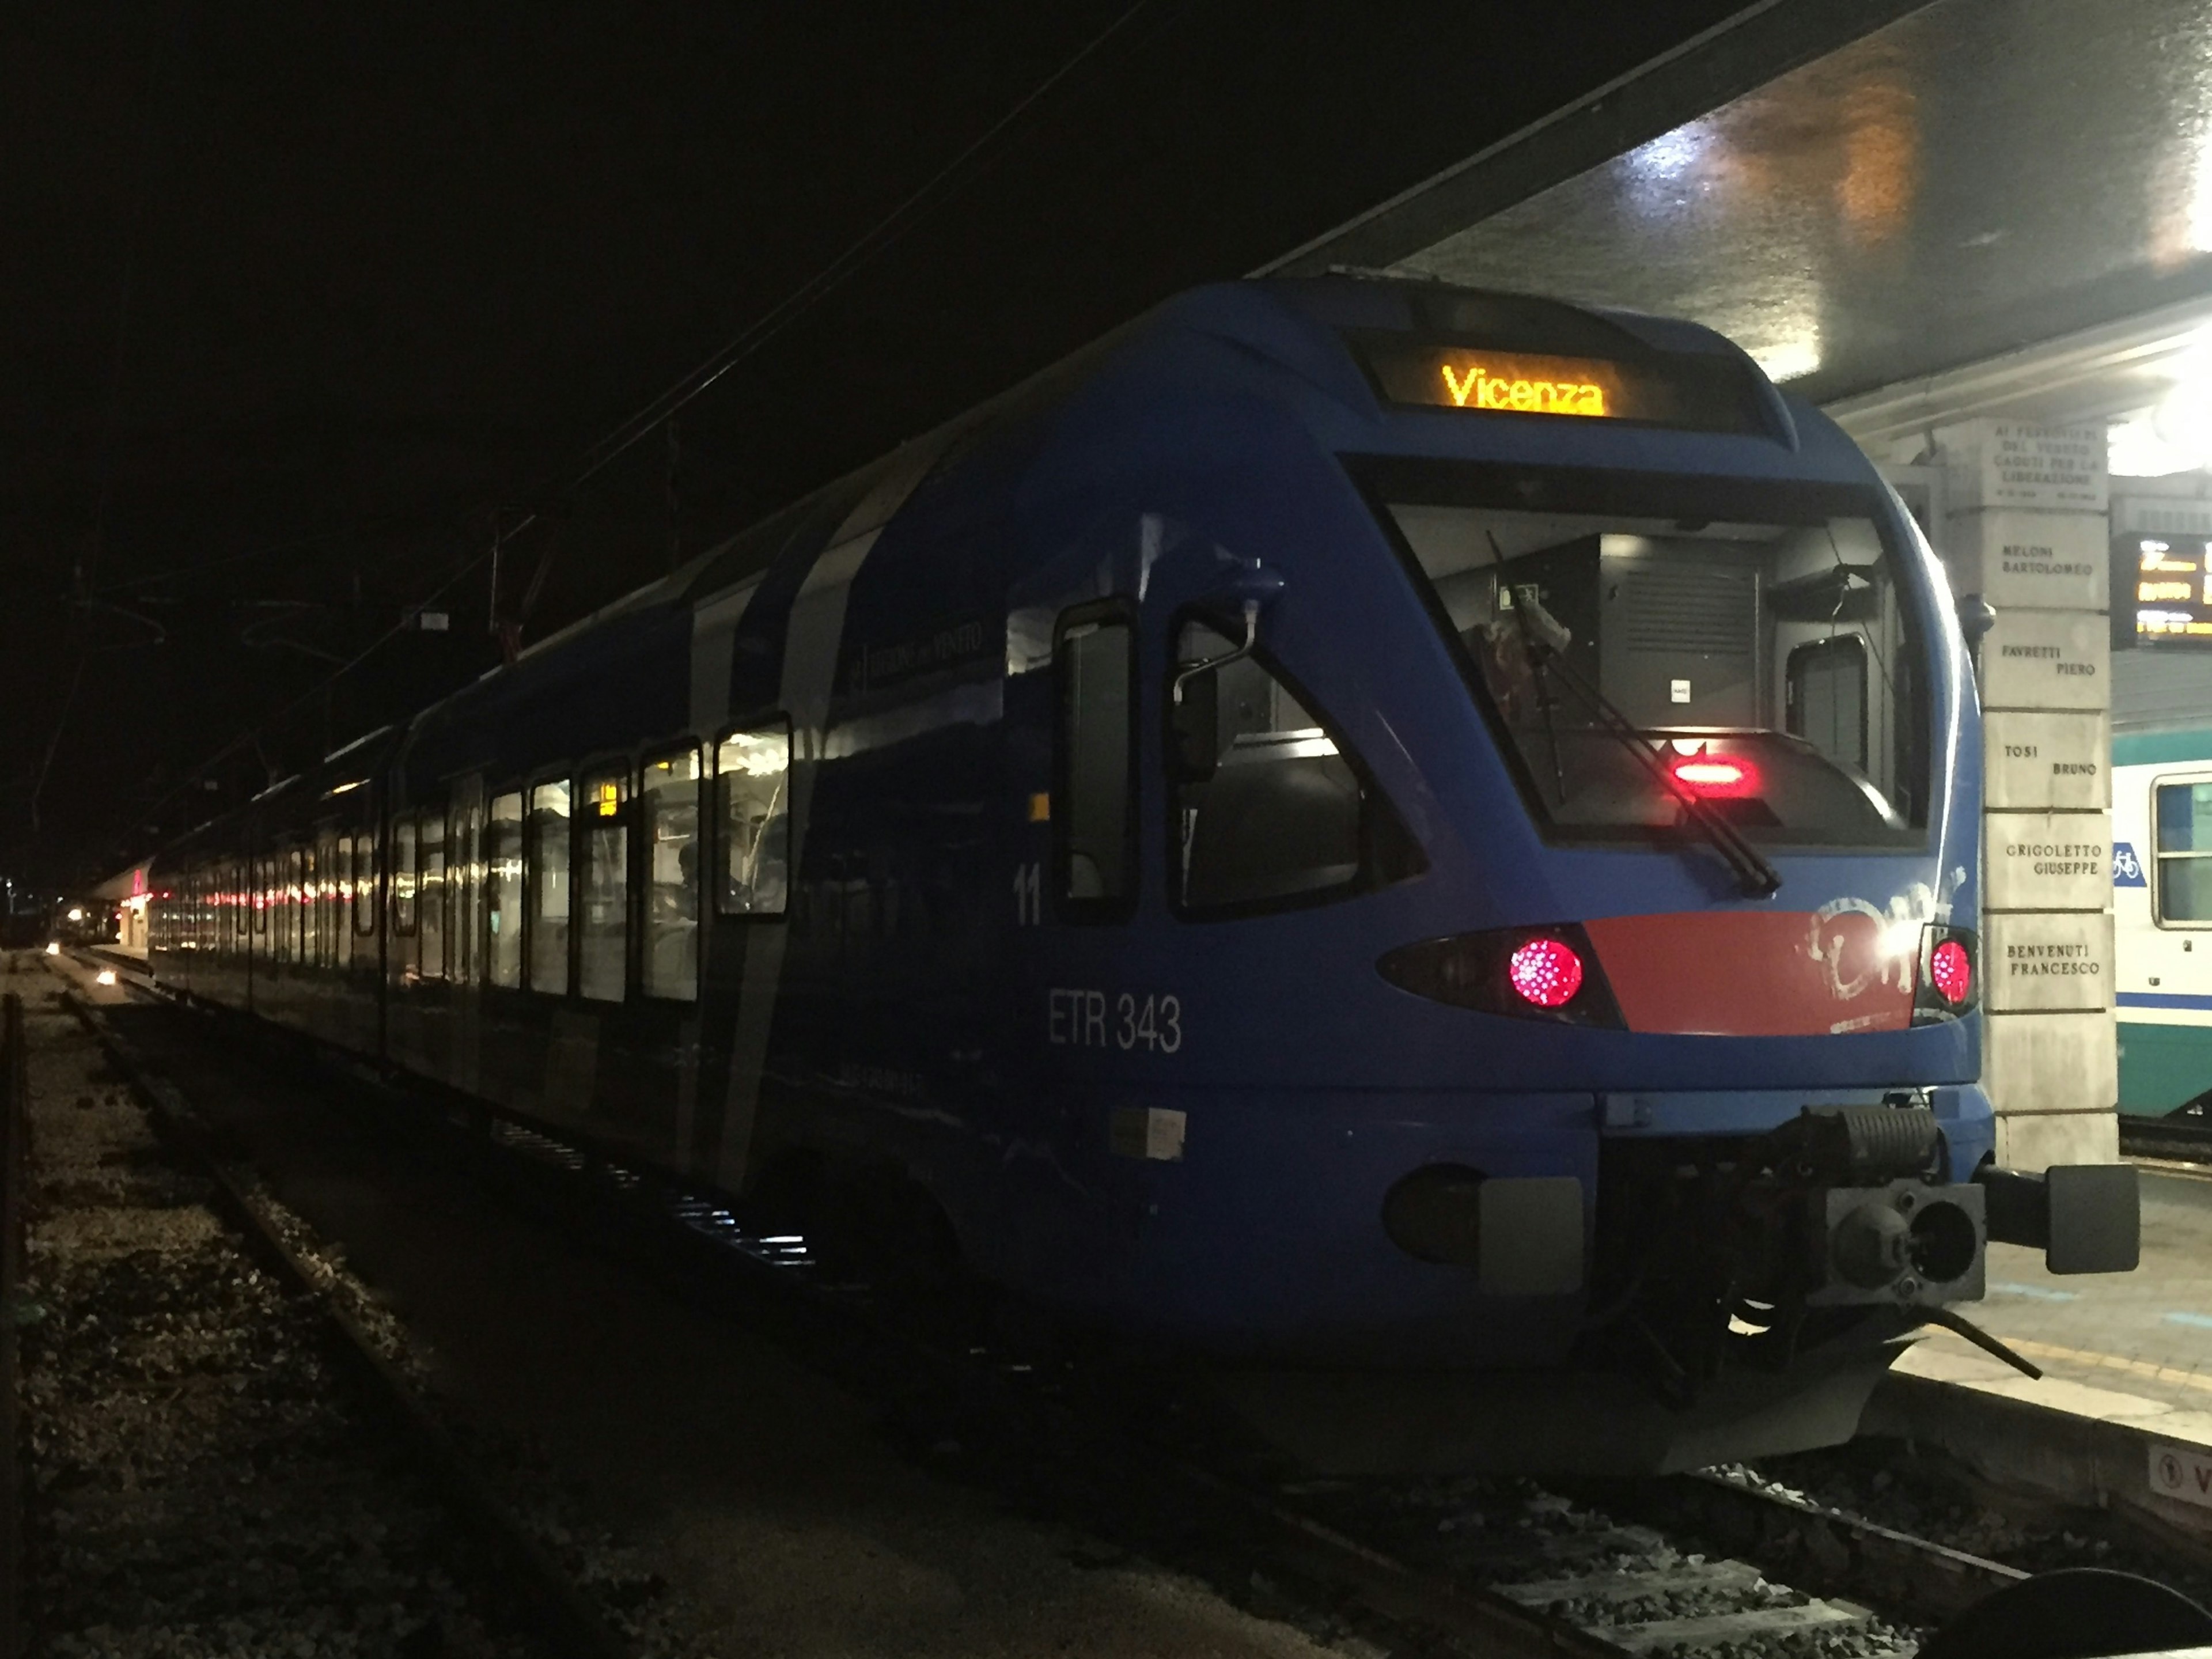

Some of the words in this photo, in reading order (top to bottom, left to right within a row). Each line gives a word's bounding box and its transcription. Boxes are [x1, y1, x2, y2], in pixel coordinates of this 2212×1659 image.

[1442, 365, 1604, 416] Vicenza
[2002, 471, 2090, 485] LIBERAZIONE
[2003, 546, 2053, 558] MELONI
[2003, 562, 2092, 575] BARTOLOMEO
[2002, 646, 2061, 659] FAVRETTI
[2057, 664, 2096, 676] PIERO
[2005, 746, 2038, 757] TOSI
[2053, 763, 2096, 775] BRUNO
[2006, 844, 2101, 857] GRIGOLETTO
[2034, 863, 2098, 875] GIUSEPPE
[1013, 863, 1040, 925] 11
[2008, 945, 2089, 958] BENVENUTI
[2011, 963, 2100, 975] FRANCESCO
[1050, 988, 1107, 1047] ETR
[1117, 993, 1181, 1053] 343
